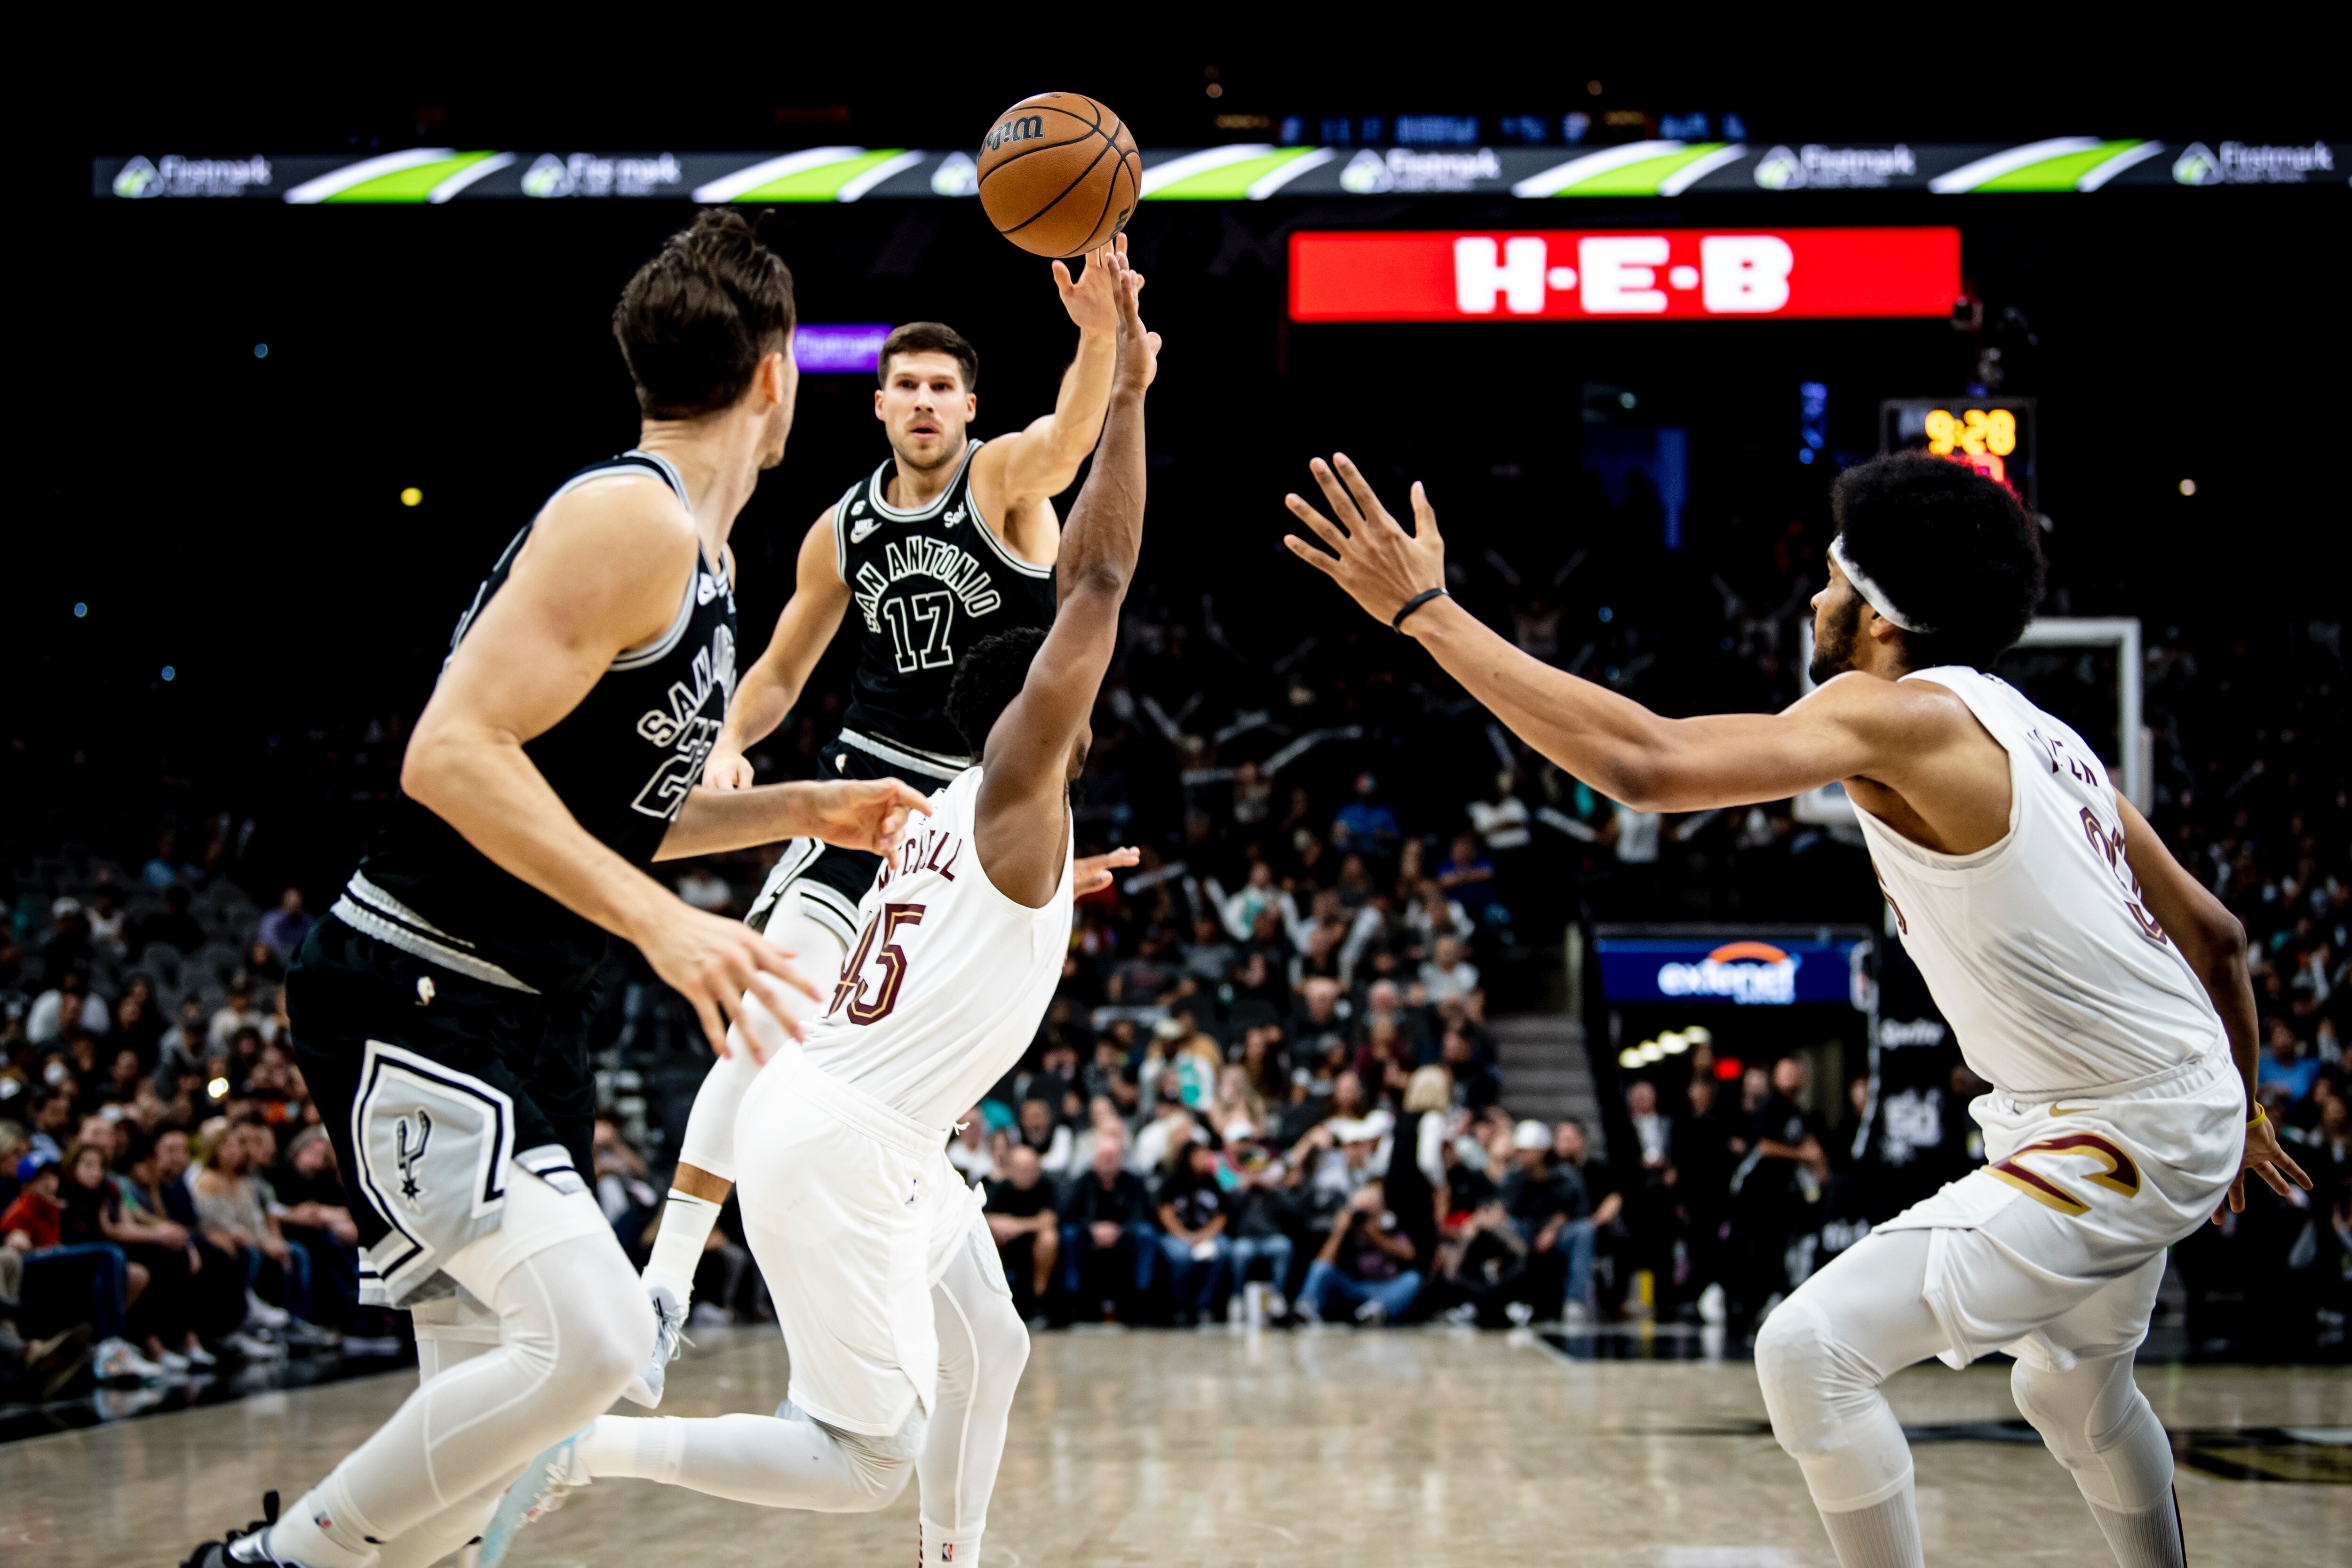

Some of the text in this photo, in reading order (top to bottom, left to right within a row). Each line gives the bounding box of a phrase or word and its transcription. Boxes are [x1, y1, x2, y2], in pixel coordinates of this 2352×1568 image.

[855, 535, 1001, 634] SAN ANTONIO
[883, 590, 954, 673] 17
